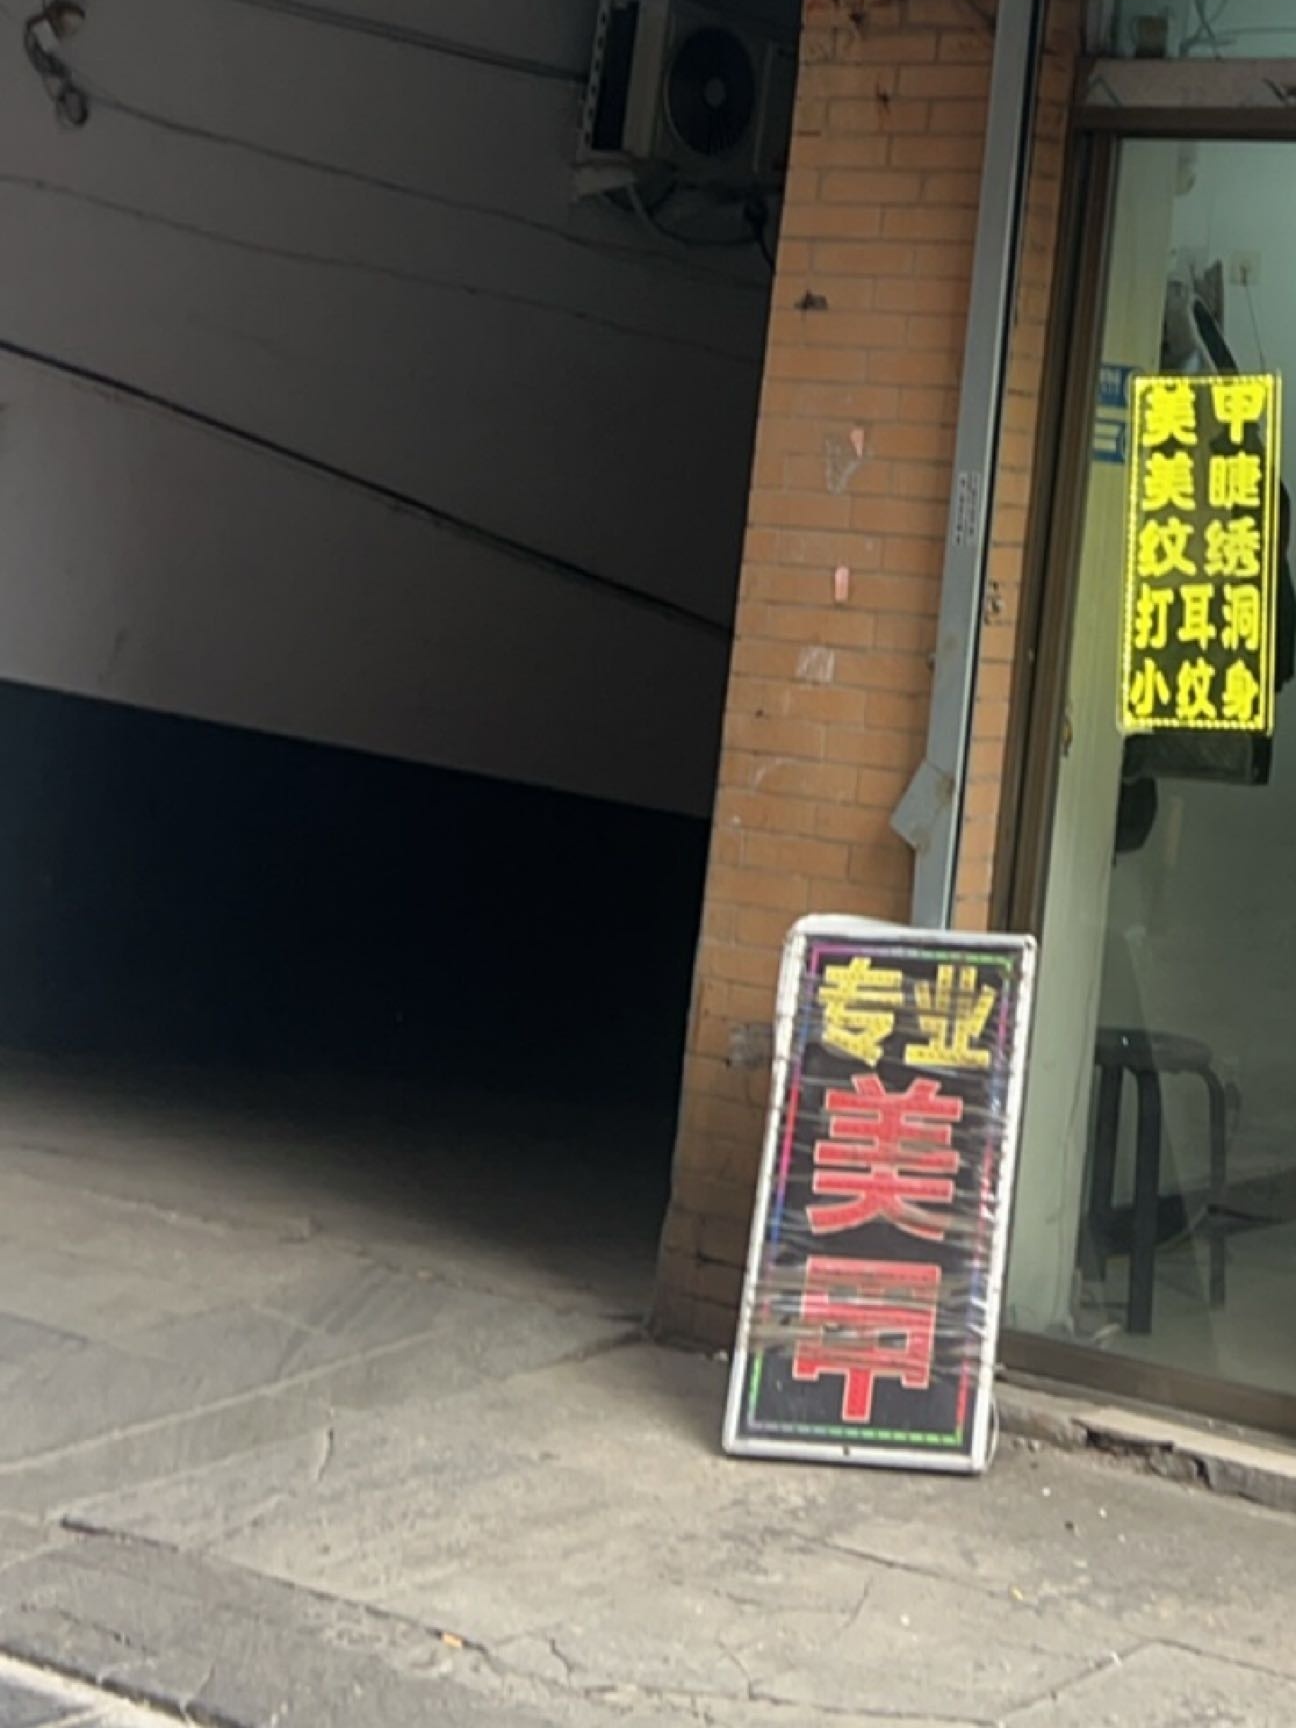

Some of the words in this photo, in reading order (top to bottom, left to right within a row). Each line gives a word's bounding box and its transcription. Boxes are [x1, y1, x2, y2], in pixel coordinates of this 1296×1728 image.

[1142, 380, 1267, 447] 美甲
[1142, 450, 1262, 512] 美睫
[1136, 515, 1262, 579] 纹绣
[1134, 583, 1261, 652] 打耳洞
[1128, 657, 1260, 721] 小纹身
[817, 956, 996, 1068] 专业
[791, 1073, 964, 1424] 美甲
